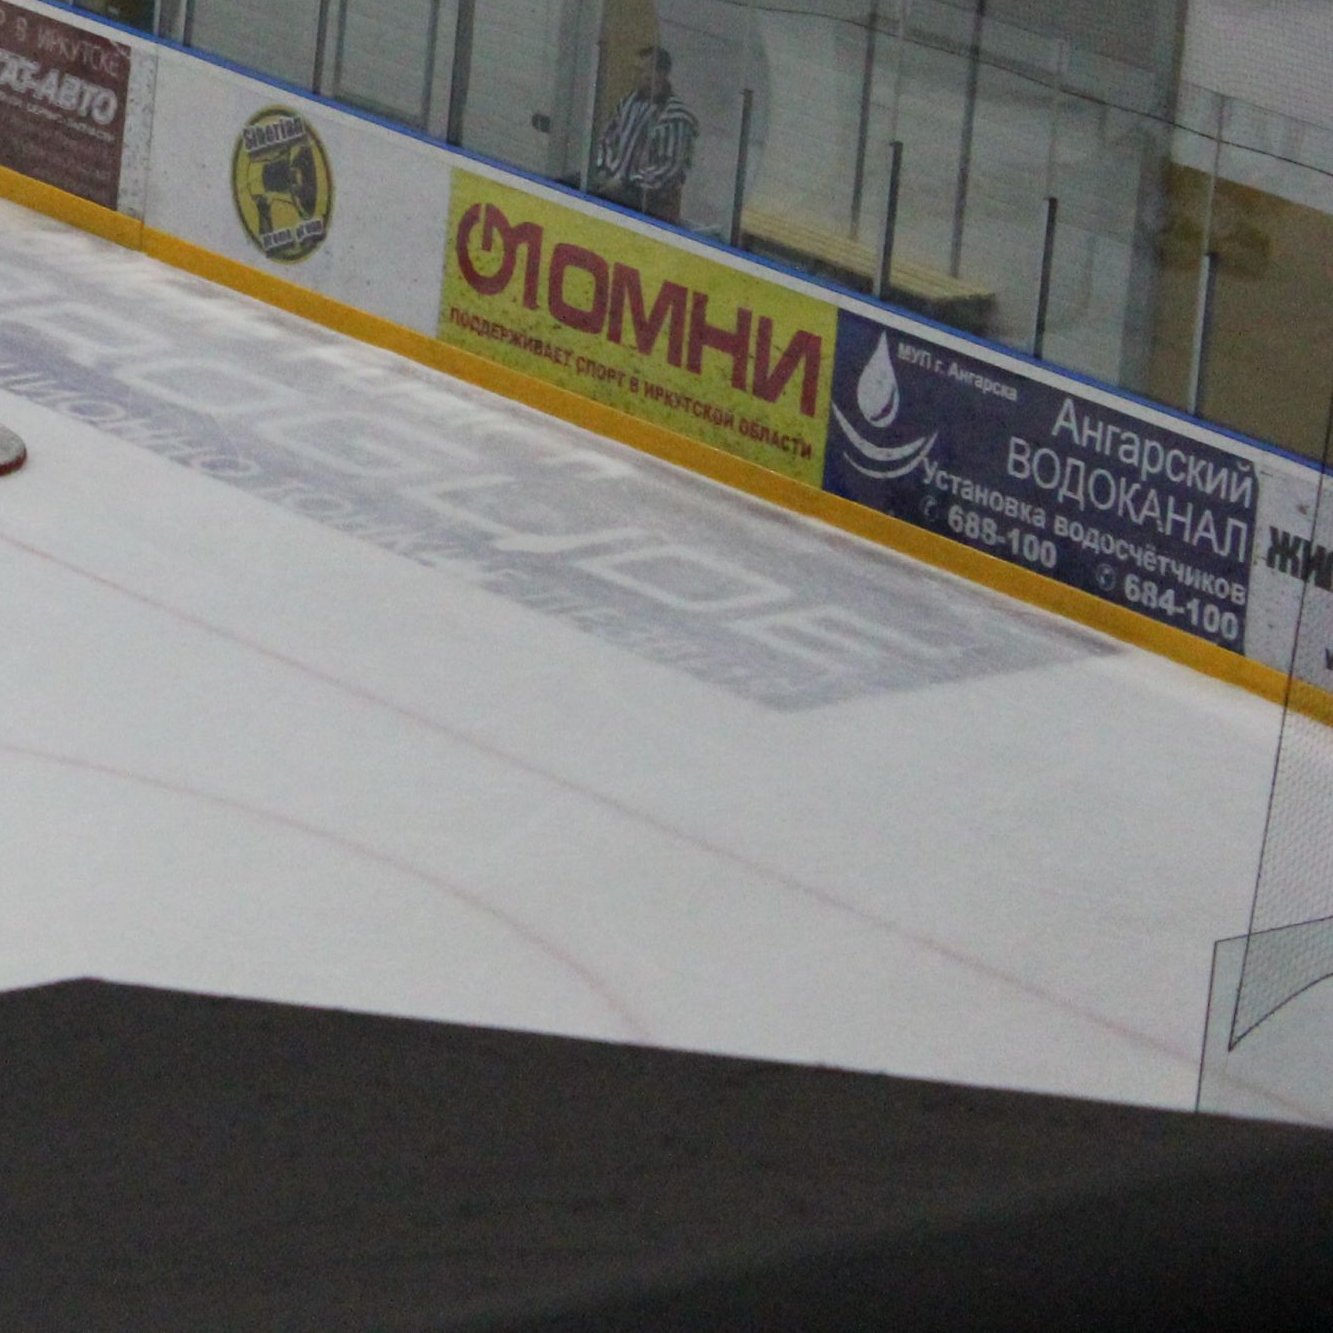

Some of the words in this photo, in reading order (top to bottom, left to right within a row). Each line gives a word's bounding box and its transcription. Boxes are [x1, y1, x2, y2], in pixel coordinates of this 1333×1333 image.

[449, 306, 573, 365] ПОДДЕРЖИВАЕТ
[576, 355, 625, 388] СПОРТ
[628, 374, 639, 394] В
[643, 380, 735, 429] ИРКУТСКОЙ
[739, 416, 813, 460] ОБЛАСТИ
[897, 341, 933, 369] МУП
[947, 362, 1018, 402] Ангарска
[1006, 436, 1249, 563] ВОДОКАНАЛ
[1051, 397, 1253, 509] Ангарский
[917, 452, 1047, 530] Установка
[1053, 515, 1247, 605] водосчётчиков
[947, 504, 1058, 570] 688-100
[1123, 573, 1240, 641] 684-100
